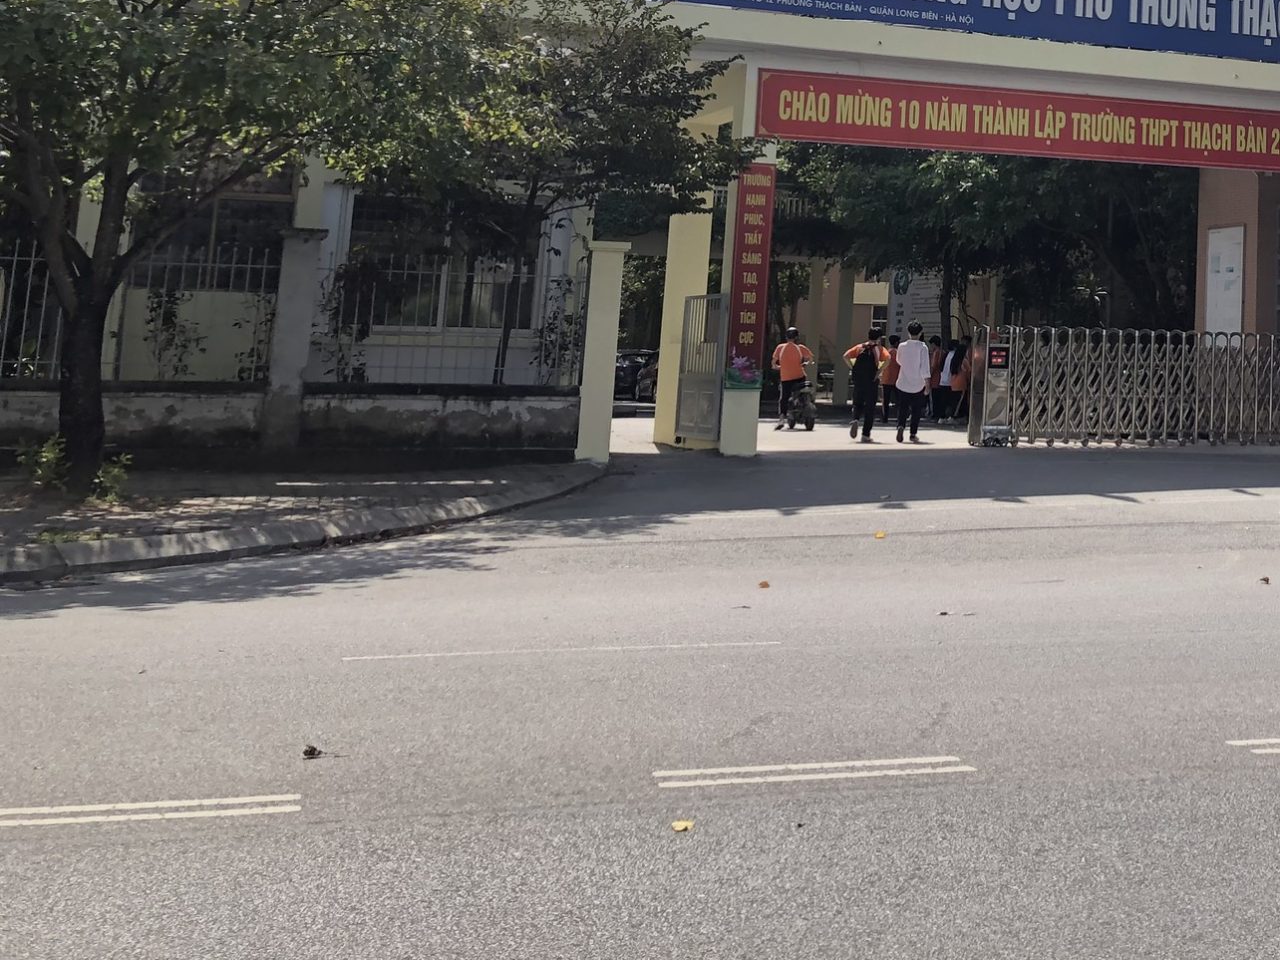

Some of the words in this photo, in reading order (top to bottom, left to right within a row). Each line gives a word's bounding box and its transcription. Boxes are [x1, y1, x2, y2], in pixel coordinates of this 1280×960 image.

[815, 0, 843, 12] THẠCH
[844, 1, 862, 12] BÀN
[869, 5, 894, 17] QUẬN
[896, 10, 920, 18] LONG
[921, 10, 939, 20] BIÊN
[945, 12, 957, 23] HÀ
[959, 14, 974, 25] NỘI
[779, 85, 830, 123] CHÀO
[836, 89, 892, 127] MỪNG
[899, 98, 920, 129] 10
[925, 95, 967, 133] NĂM
[973, 100, 1029, 137] THÀNH
[1035, 104, 1066, 145] LẬP
[1072, 108, 1135, 144] TRƯỜNG
[1140, 117, 1177, 147] THPT
[1183, 120, 1231, 155] THẠCH
[1236, 120, 1267, 155] BÀN
[745, 193, 766, 208] HẠNH
[742, 249, 762, 265] SÁNG
[740, 309, 756, 324] TÍCH
[739, 330, 754, 346] CỰC
